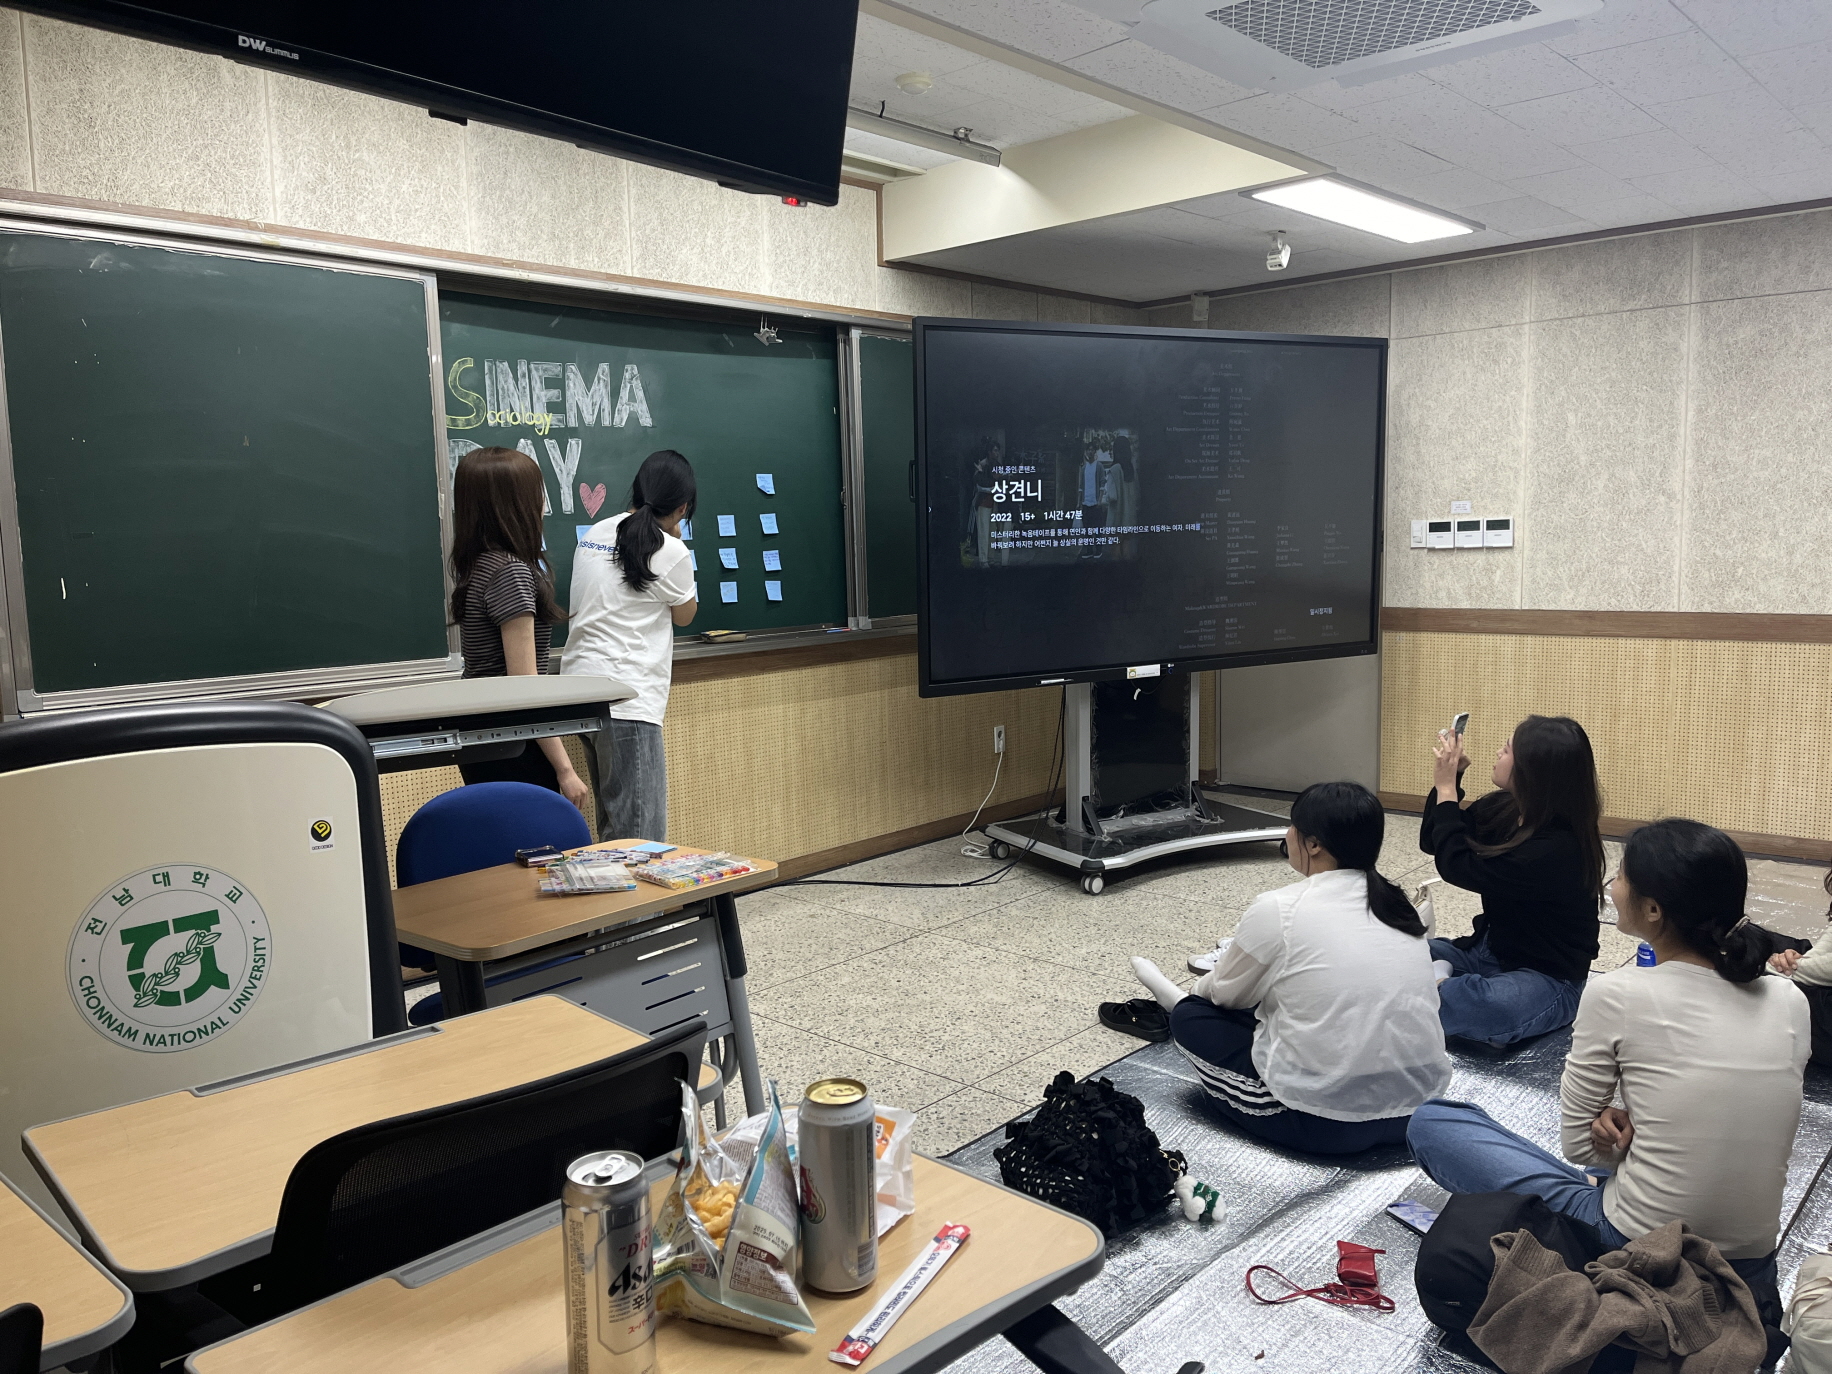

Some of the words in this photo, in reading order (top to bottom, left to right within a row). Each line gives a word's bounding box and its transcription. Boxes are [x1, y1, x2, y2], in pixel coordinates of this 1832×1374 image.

[446, 357, 653, 430] SINEMA
[990, 479, 1042, 503] 상견니
[990, 513, 1012, 522] 2022
[1020, 512, 1035, 521] 15+
[1043, 511, 1064, 522] 1시간
[1065, 510, 1083, 520] 47분
[78, 975, 139, 1043] CHONNAM
[142, 1016, 230, 1047] NATIONAL
[228, 936, 267, 1015] UNIVERSITY
